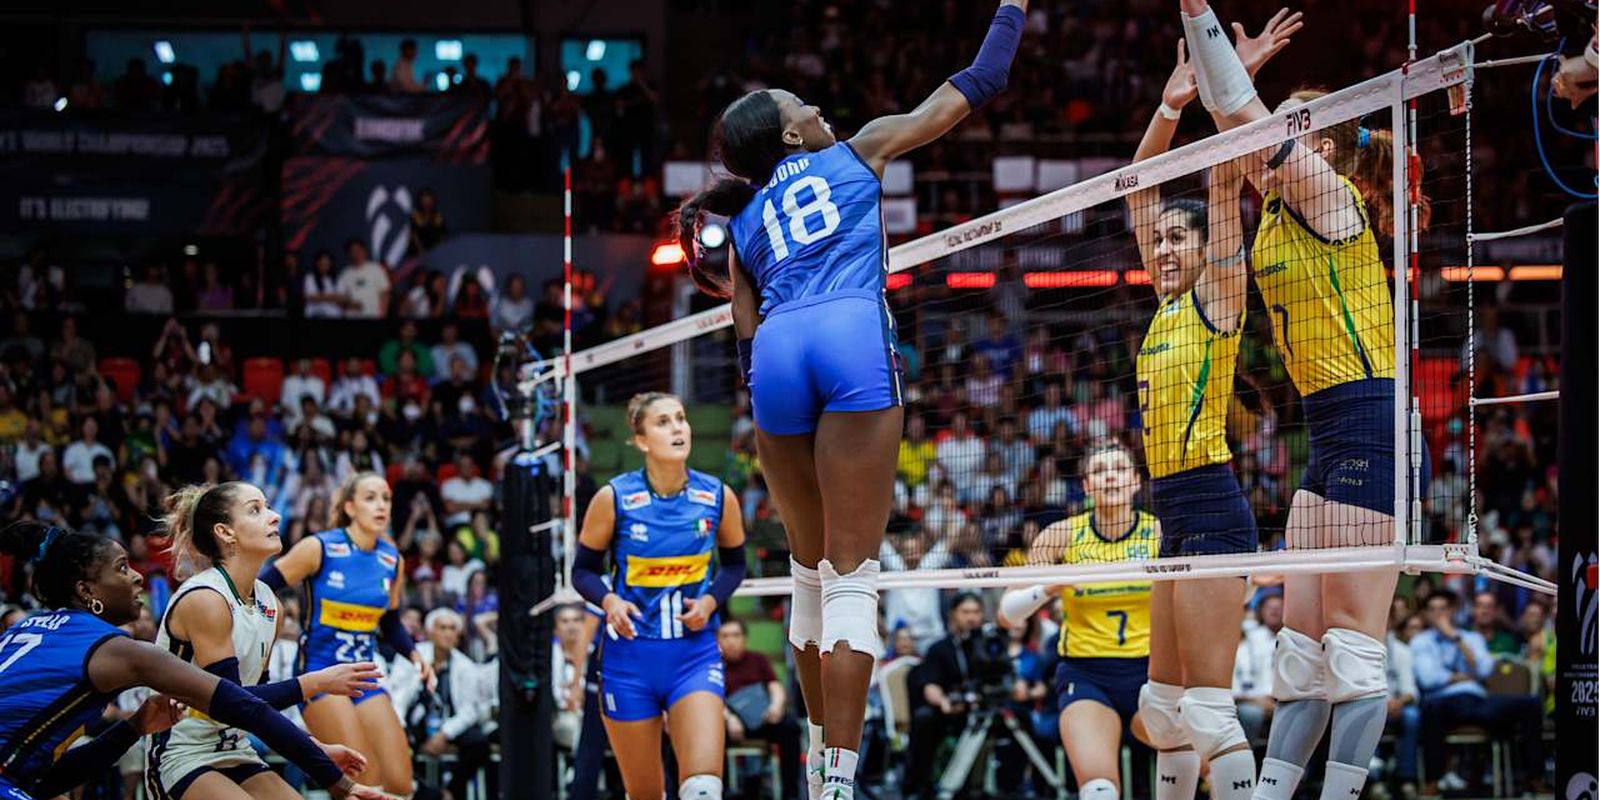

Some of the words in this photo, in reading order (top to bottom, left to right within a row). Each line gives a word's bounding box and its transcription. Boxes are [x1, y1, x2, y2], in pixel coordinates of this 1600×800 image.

[1284, 107, 1310, 138] FIVB
[762, 175, 841, 262] 18
[660, 590, 684, 640] 11
[1106, 610, 1128, 646] 7
[334, 631, 371, 662] 22
